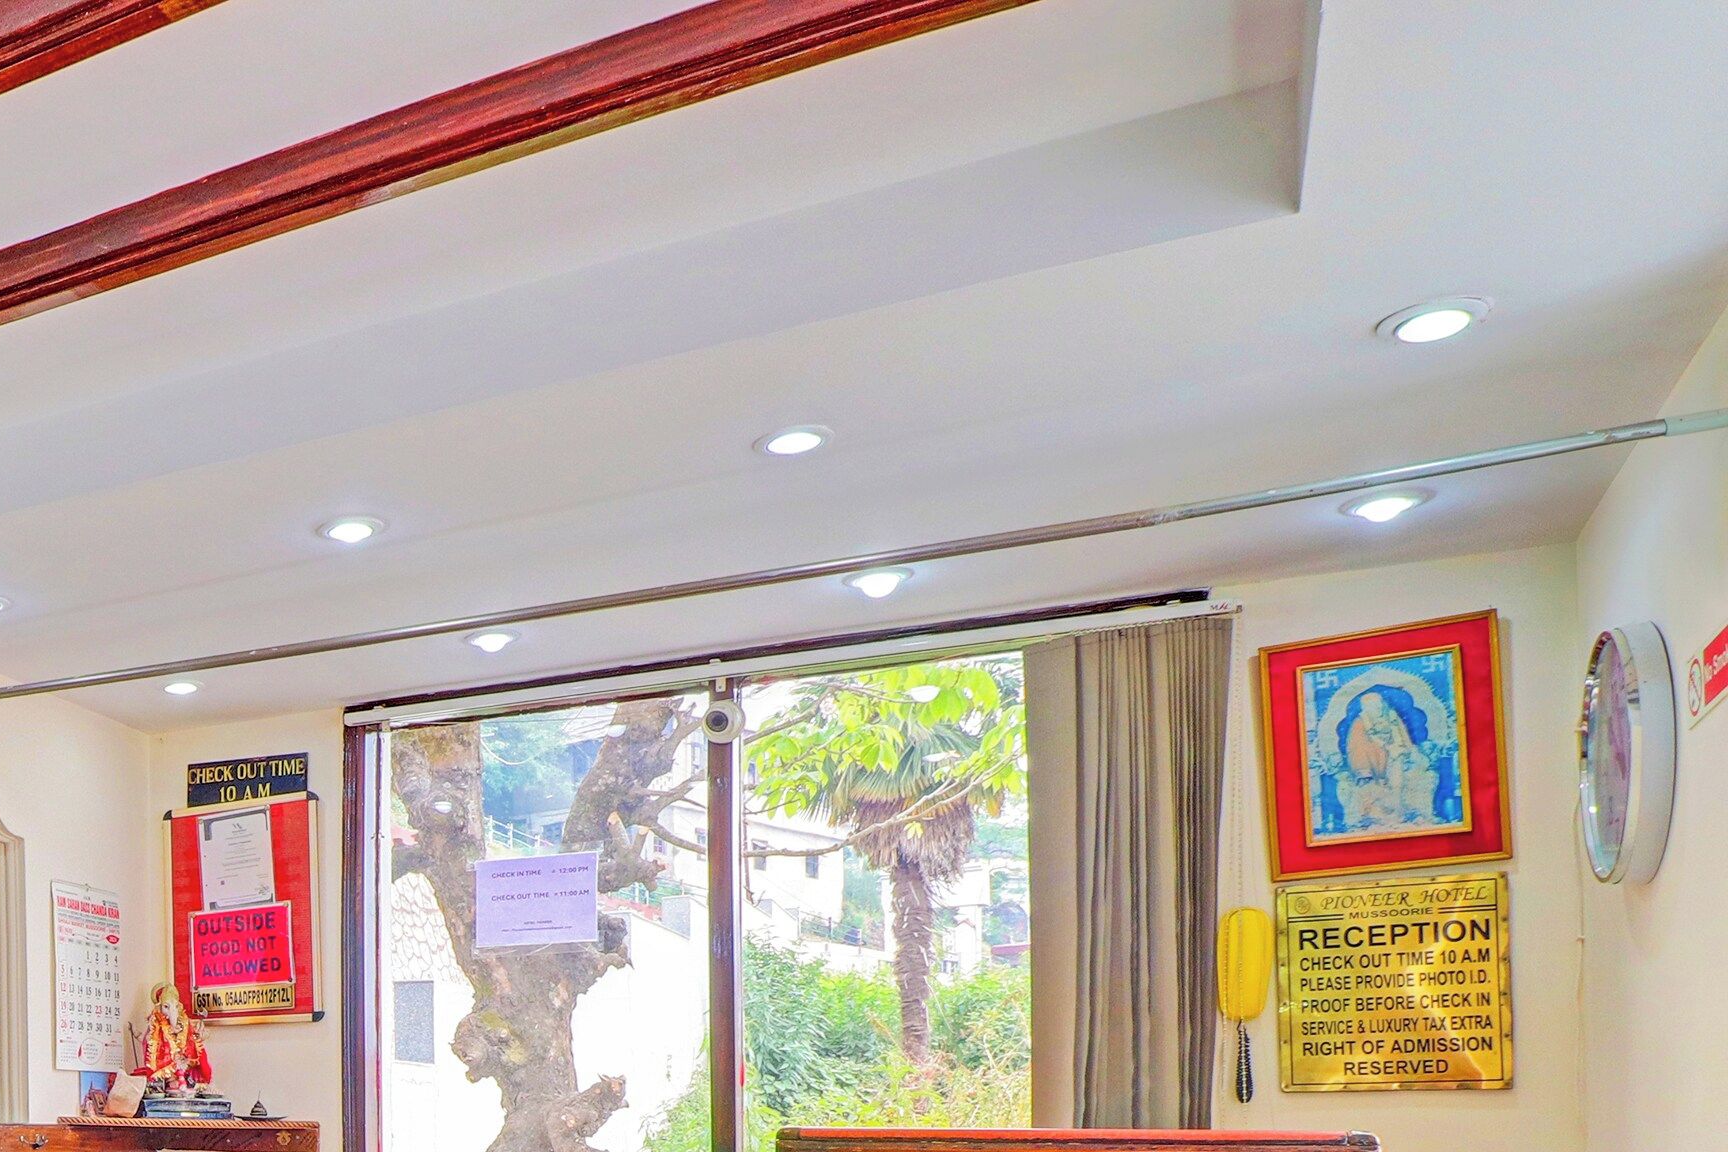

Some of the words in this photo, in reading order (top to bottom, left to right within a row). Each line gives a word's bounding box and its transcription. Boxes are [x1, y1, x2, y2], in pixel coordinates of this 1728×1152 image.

[188, 765, 234, 784] CHECK
[237, 762, 266, 779] OUT
[269, 758, 305, 776] TIME
[220, 785, 237, 802] 10
[1322, 891, 1413, 910] PIONEER
[1420, 886, 1489, 903] HOTEL
[1349, 907, 1434, 919] MUSSOORIE
[198, 912, 275, 936] OUTSIDE
[1299, 918, 1490, 950] RECEPTION
[201, 940, 240, 956] FOOD
[247, 936, 276, 951] NOT
[203, 958, 281, 976] ALLOWED
[1300, 955, 1354, 971] CHECK
[1359, 953, 1391, 968] OUT
[1397, 951, 1434, 966] TIME
[1441, 950, 1457, 964] 10
[1461, 948, 1490, 963] A.M
[104, 971, 111, 980] 10
[114, 973, 120, 982] 11
[1300, 976, 1351, 991] PLEASE
[1356, 974, 1414, 989] PROVIDE
[1419, 971, 1466, 986] PHOTO
[1470, 969, 1491, 985] I.D.
[60, 982, 66, 992] 12
[77, 985, 83, 995] 14
[86, 986, 92, 996] 15
[95, 987, 101, 997] 16
[104, 989, 111, 998] 17
[114, 990, 120, 999] 18
[197, 994, 210, 1007] GST
[212, 993, 223, 1006] No.
[61, 1001, 66, 1011] 19
[69, 1001, 75, 1011] 20
[77, 1003, 83, 1012] 21
[86, 1004, 92, 1013] 22
[95, 1005, 102, 1015] 23
[104, 1006, 111, 1015] 24
[114, 1007, 120, 1017] 25
[1301, 998, 1349, 1013] PROOF
[1356, 996, 1414, 1012] BEFORE
[1421, 994, 1472, 1009] CHECK
[1477, 992, 1490, 1006] IN
[60, 1019, 67, 1029] 26
[69, 1020, 75, 1029] 27
[78, 1021, 84, 1031] 28
[86, 1021, 92, 1031] 29
[95, 1022, 102, 1032] 30
[104, 1023, 112, 1033] 31
[1301, 1020, 1353, 1035] SERVICE
[1358, 1021, 1365, 1034] &
[1369, 1018, 1418, 1034] LUXURY
[1423, 1017, 1446, 1032] TAX
[1451, 1015, 1493, 1031] EXTRA
[1303, 1041, 1355, 1056] RIGHT
[1361, 1039, 1385, 1054] OF
[1391, 1037, 1493, 1054] ADMISSION
[1344, 1059, 1449, 1075] RESERVED
